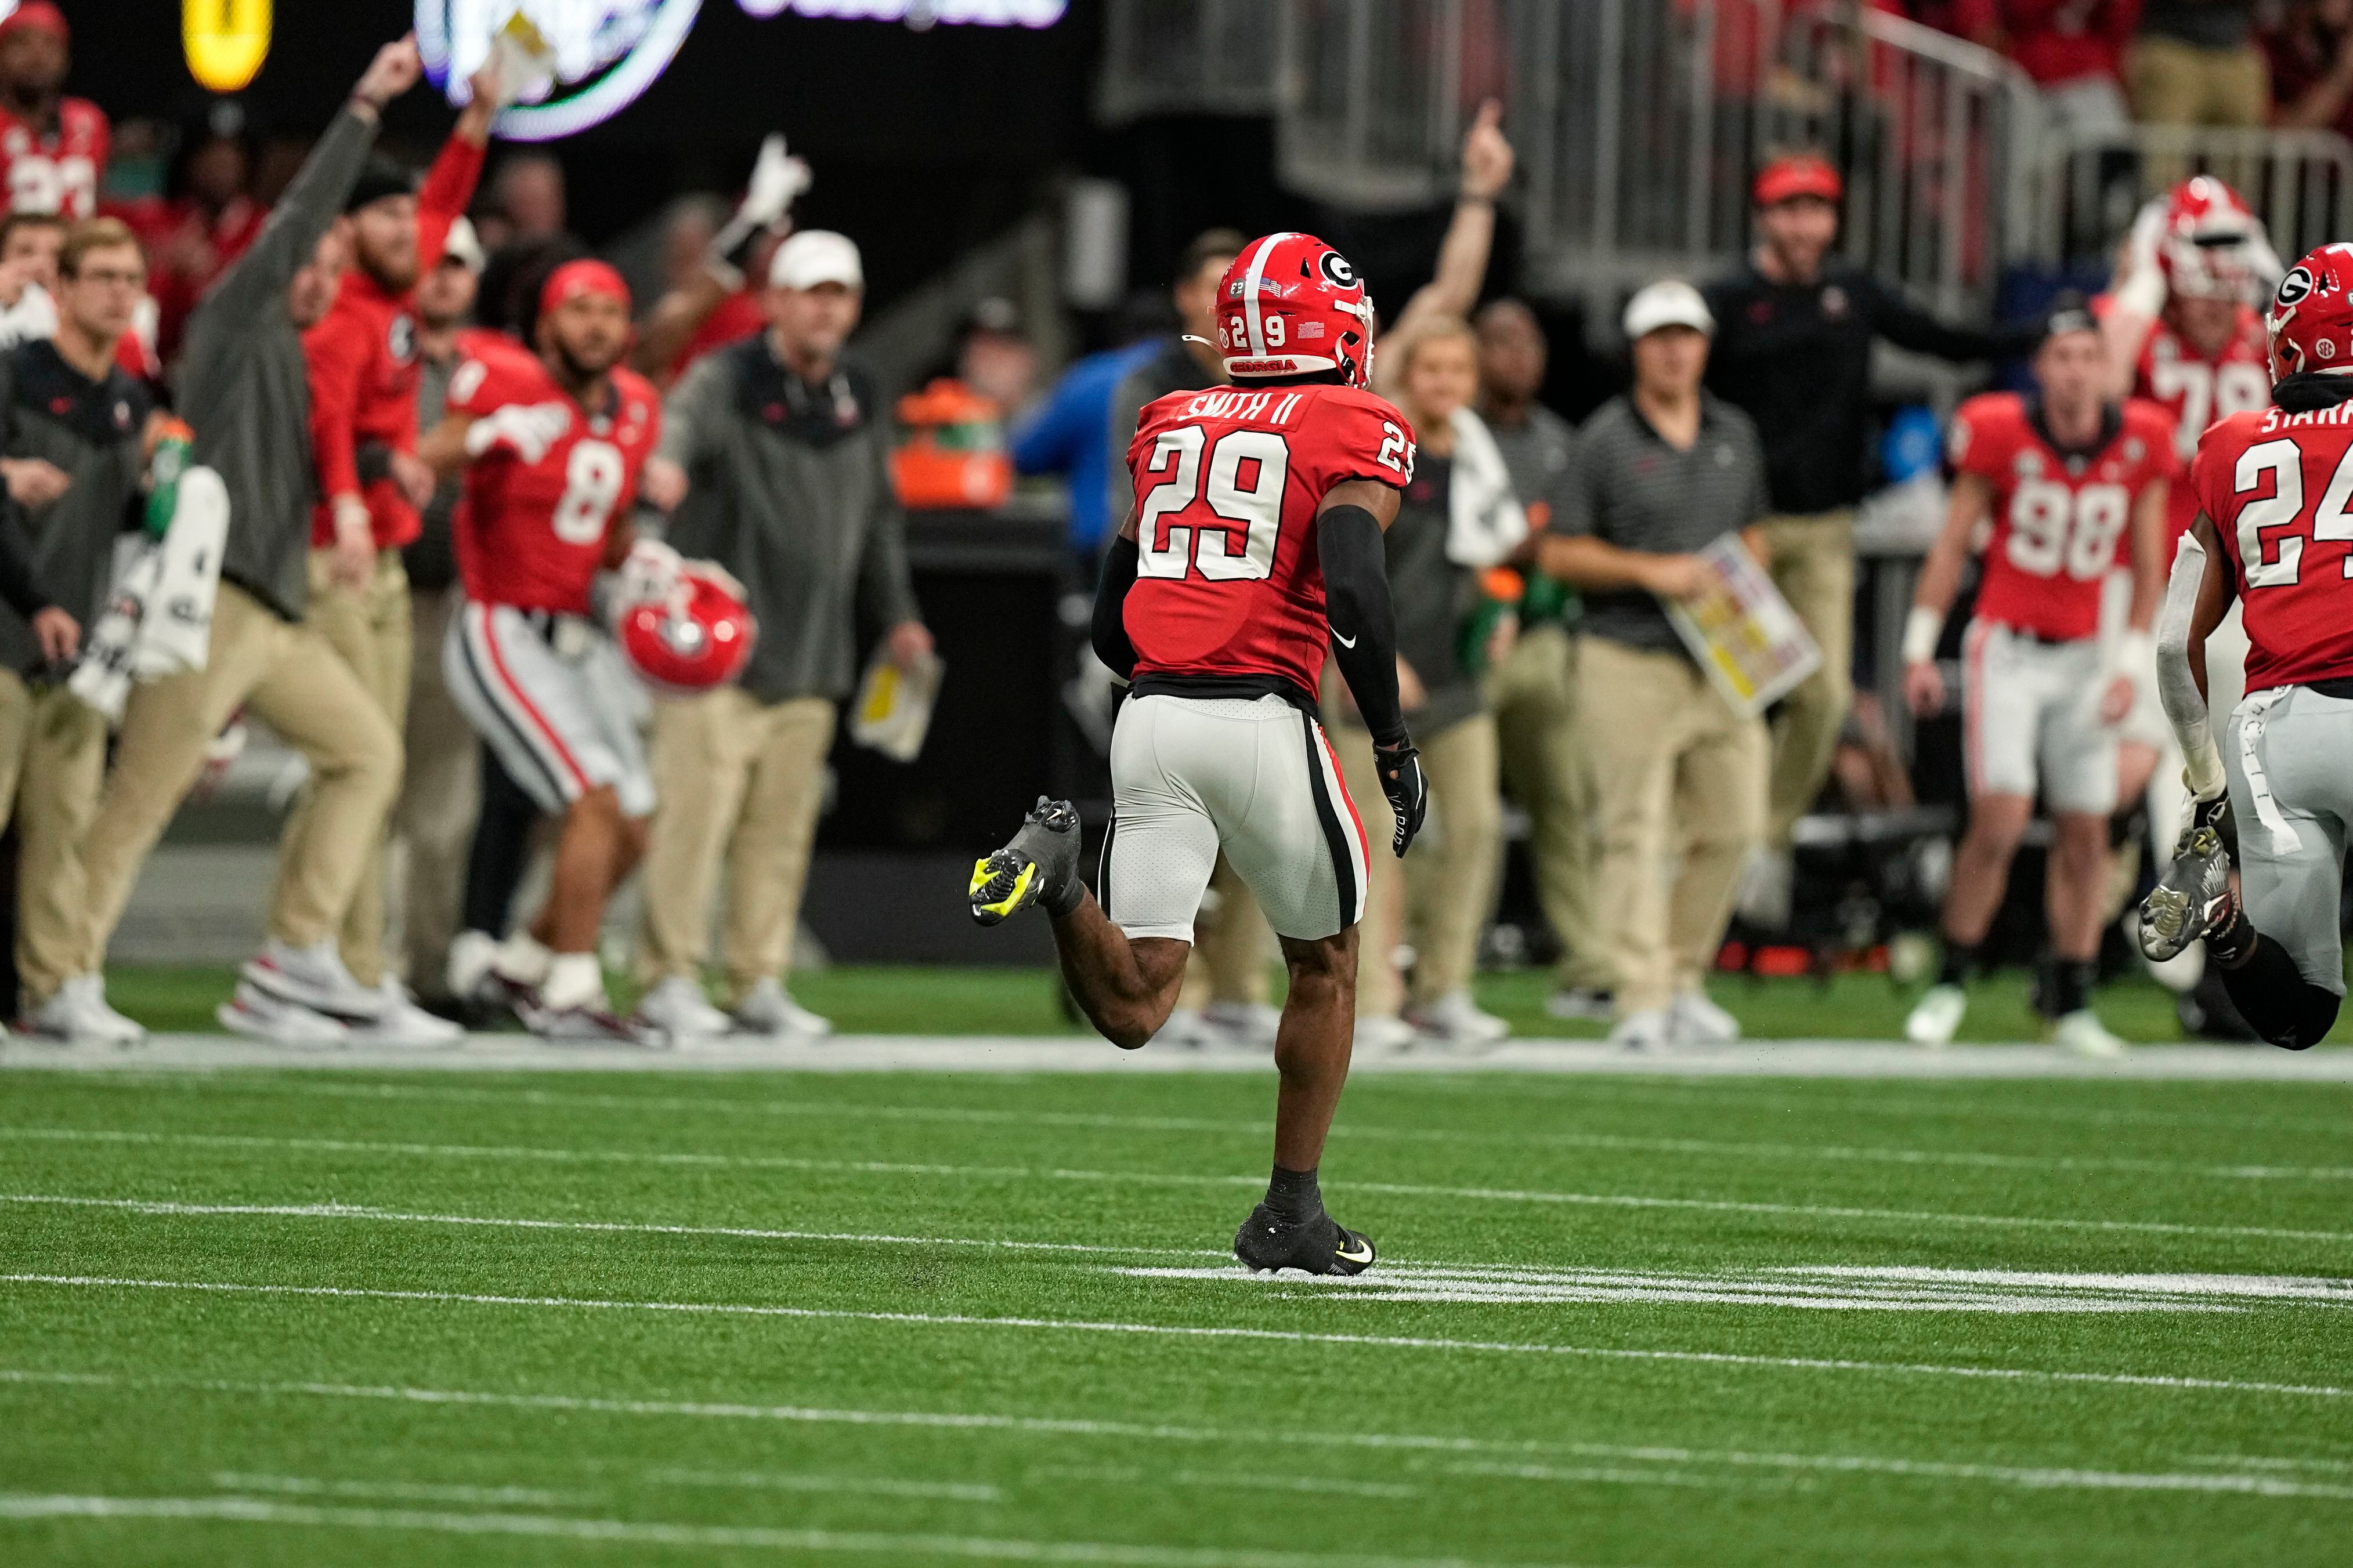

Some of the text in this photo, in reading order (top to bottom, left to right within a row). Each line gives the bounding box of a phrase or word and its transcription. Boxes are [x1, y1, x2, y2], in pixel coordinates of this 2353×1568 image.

[1321, 252, 1357, 287] G
[2278, 269, 2311, 303] G
[1230, 359, 1298, 373] GEORGIA
[2319, 341, 2333, 356] SEC
[1177, 392, 1303, 425] SMITH II
[551, 438, 624, 546] 8
[1137, 424, 1291, 582] 29
[2005, 481, 2131, 580] 98
[1387, 794, 1405, 845] VAPOR
